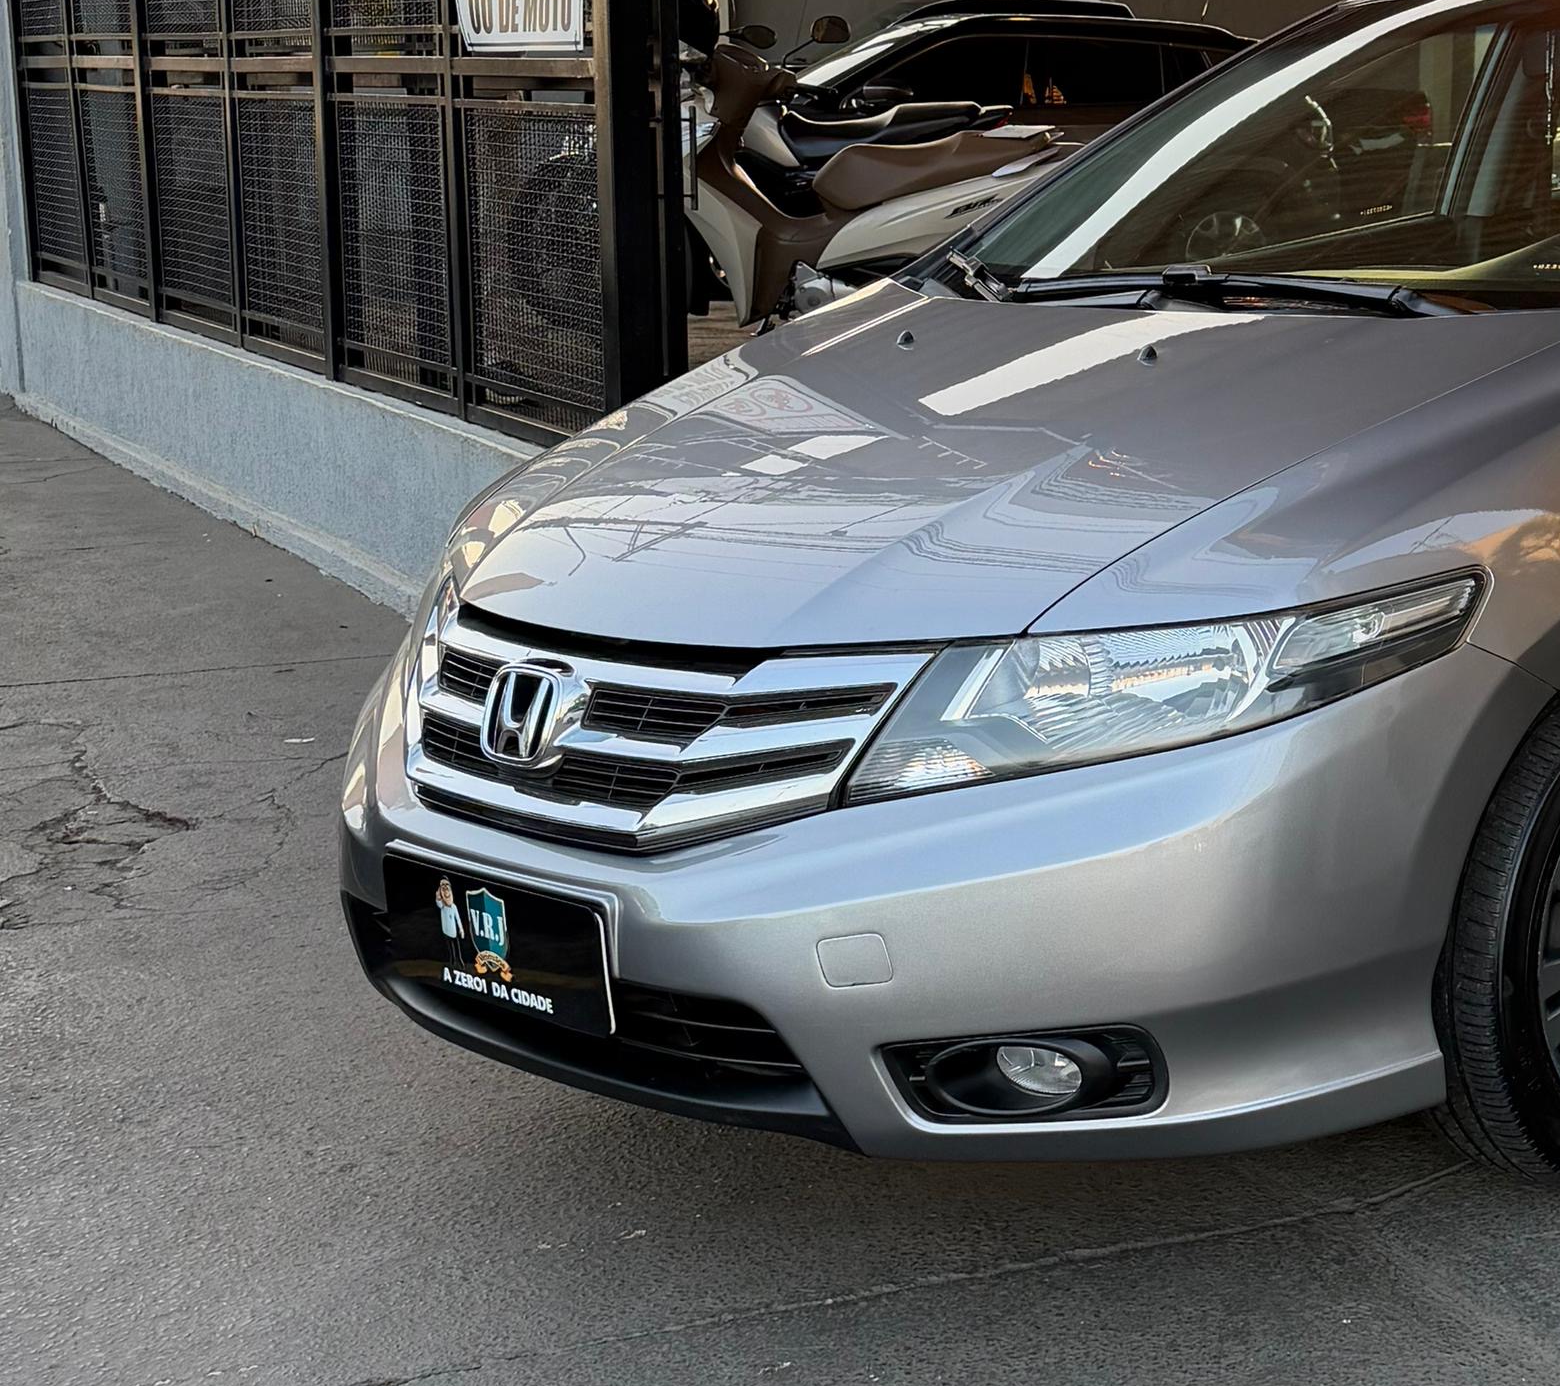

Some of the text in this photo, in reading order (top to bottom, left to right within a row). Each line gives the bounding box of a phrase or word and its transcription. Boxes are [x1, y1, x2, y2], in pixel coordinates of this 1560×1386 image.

[443, 967, 452, 984] A
[491, 981, 510, 1001] DA
[511, 988, 554, 1014] CIDADE
